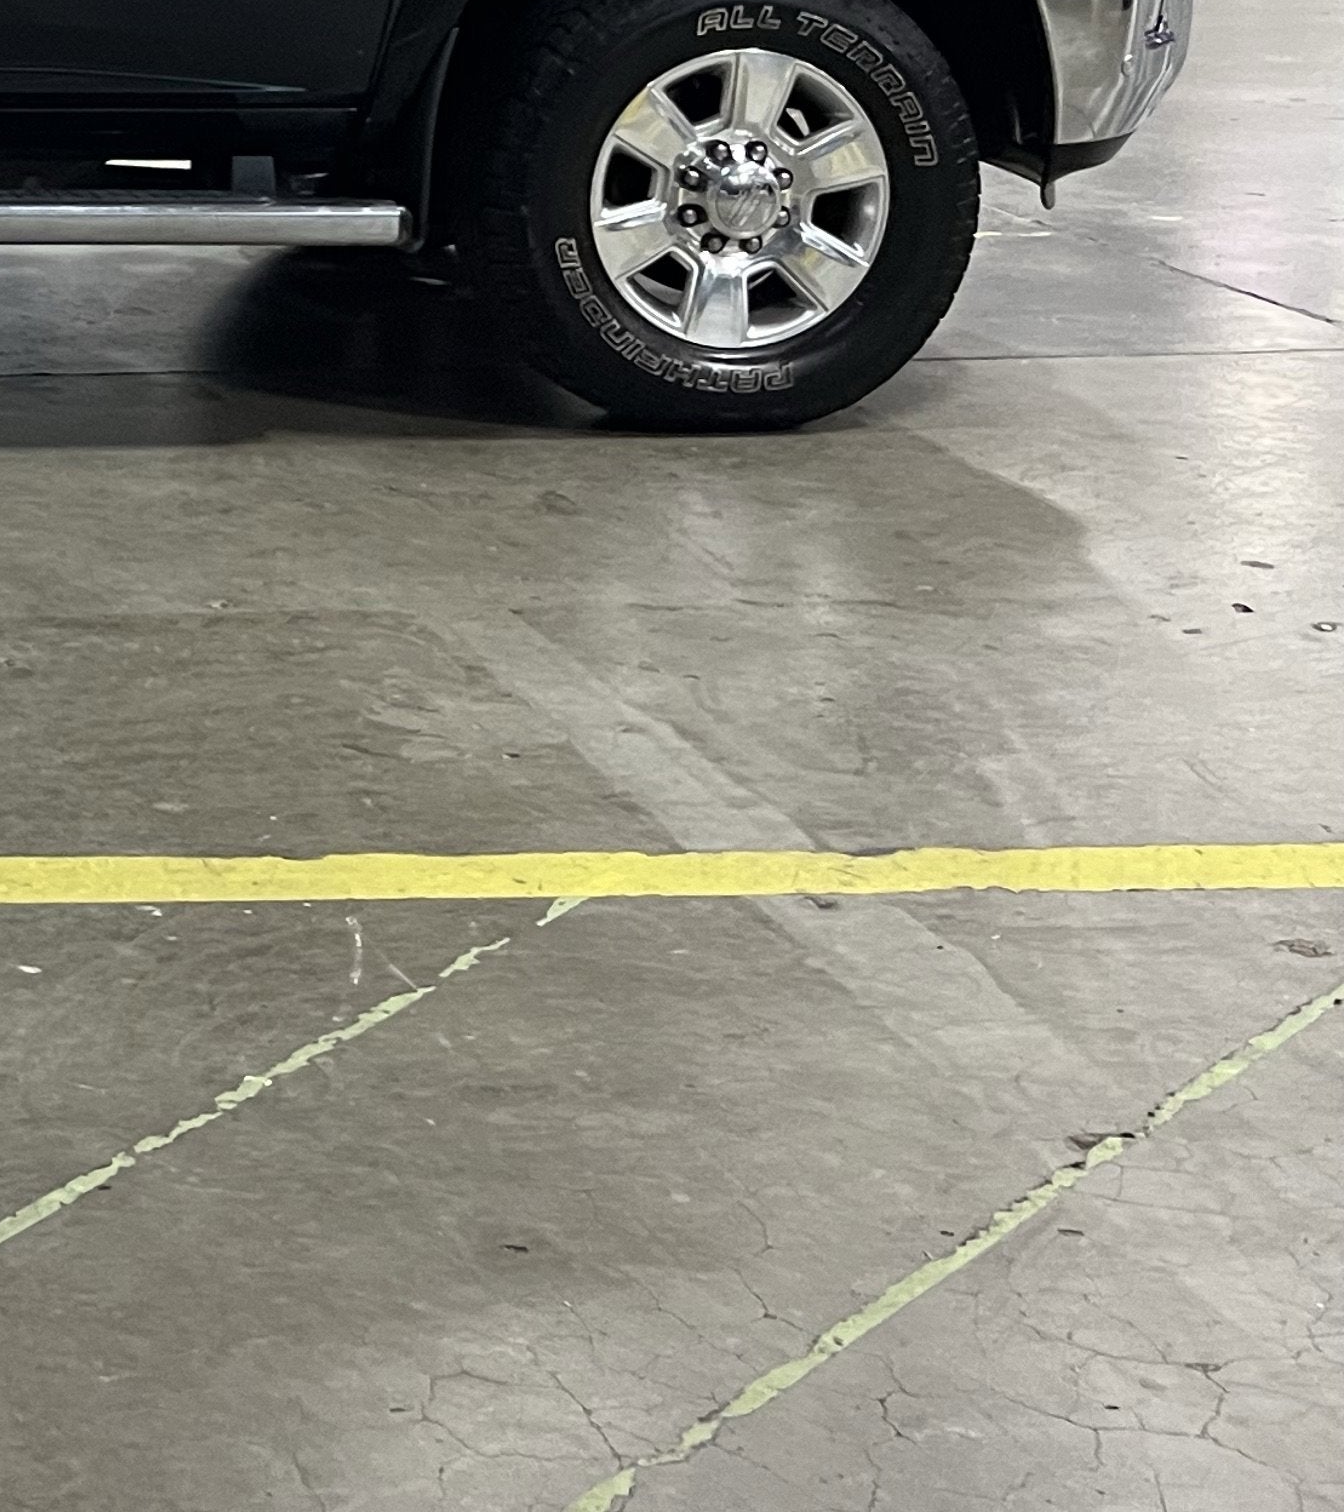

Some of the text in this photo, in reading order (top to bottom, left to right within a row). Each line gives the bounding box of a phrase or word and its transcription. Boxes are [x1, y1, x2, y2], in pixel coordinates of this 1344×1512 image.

[696, 4, 940, 168] ALL TERRAIN
[554, 235, 796, 394] PATHFINDER
